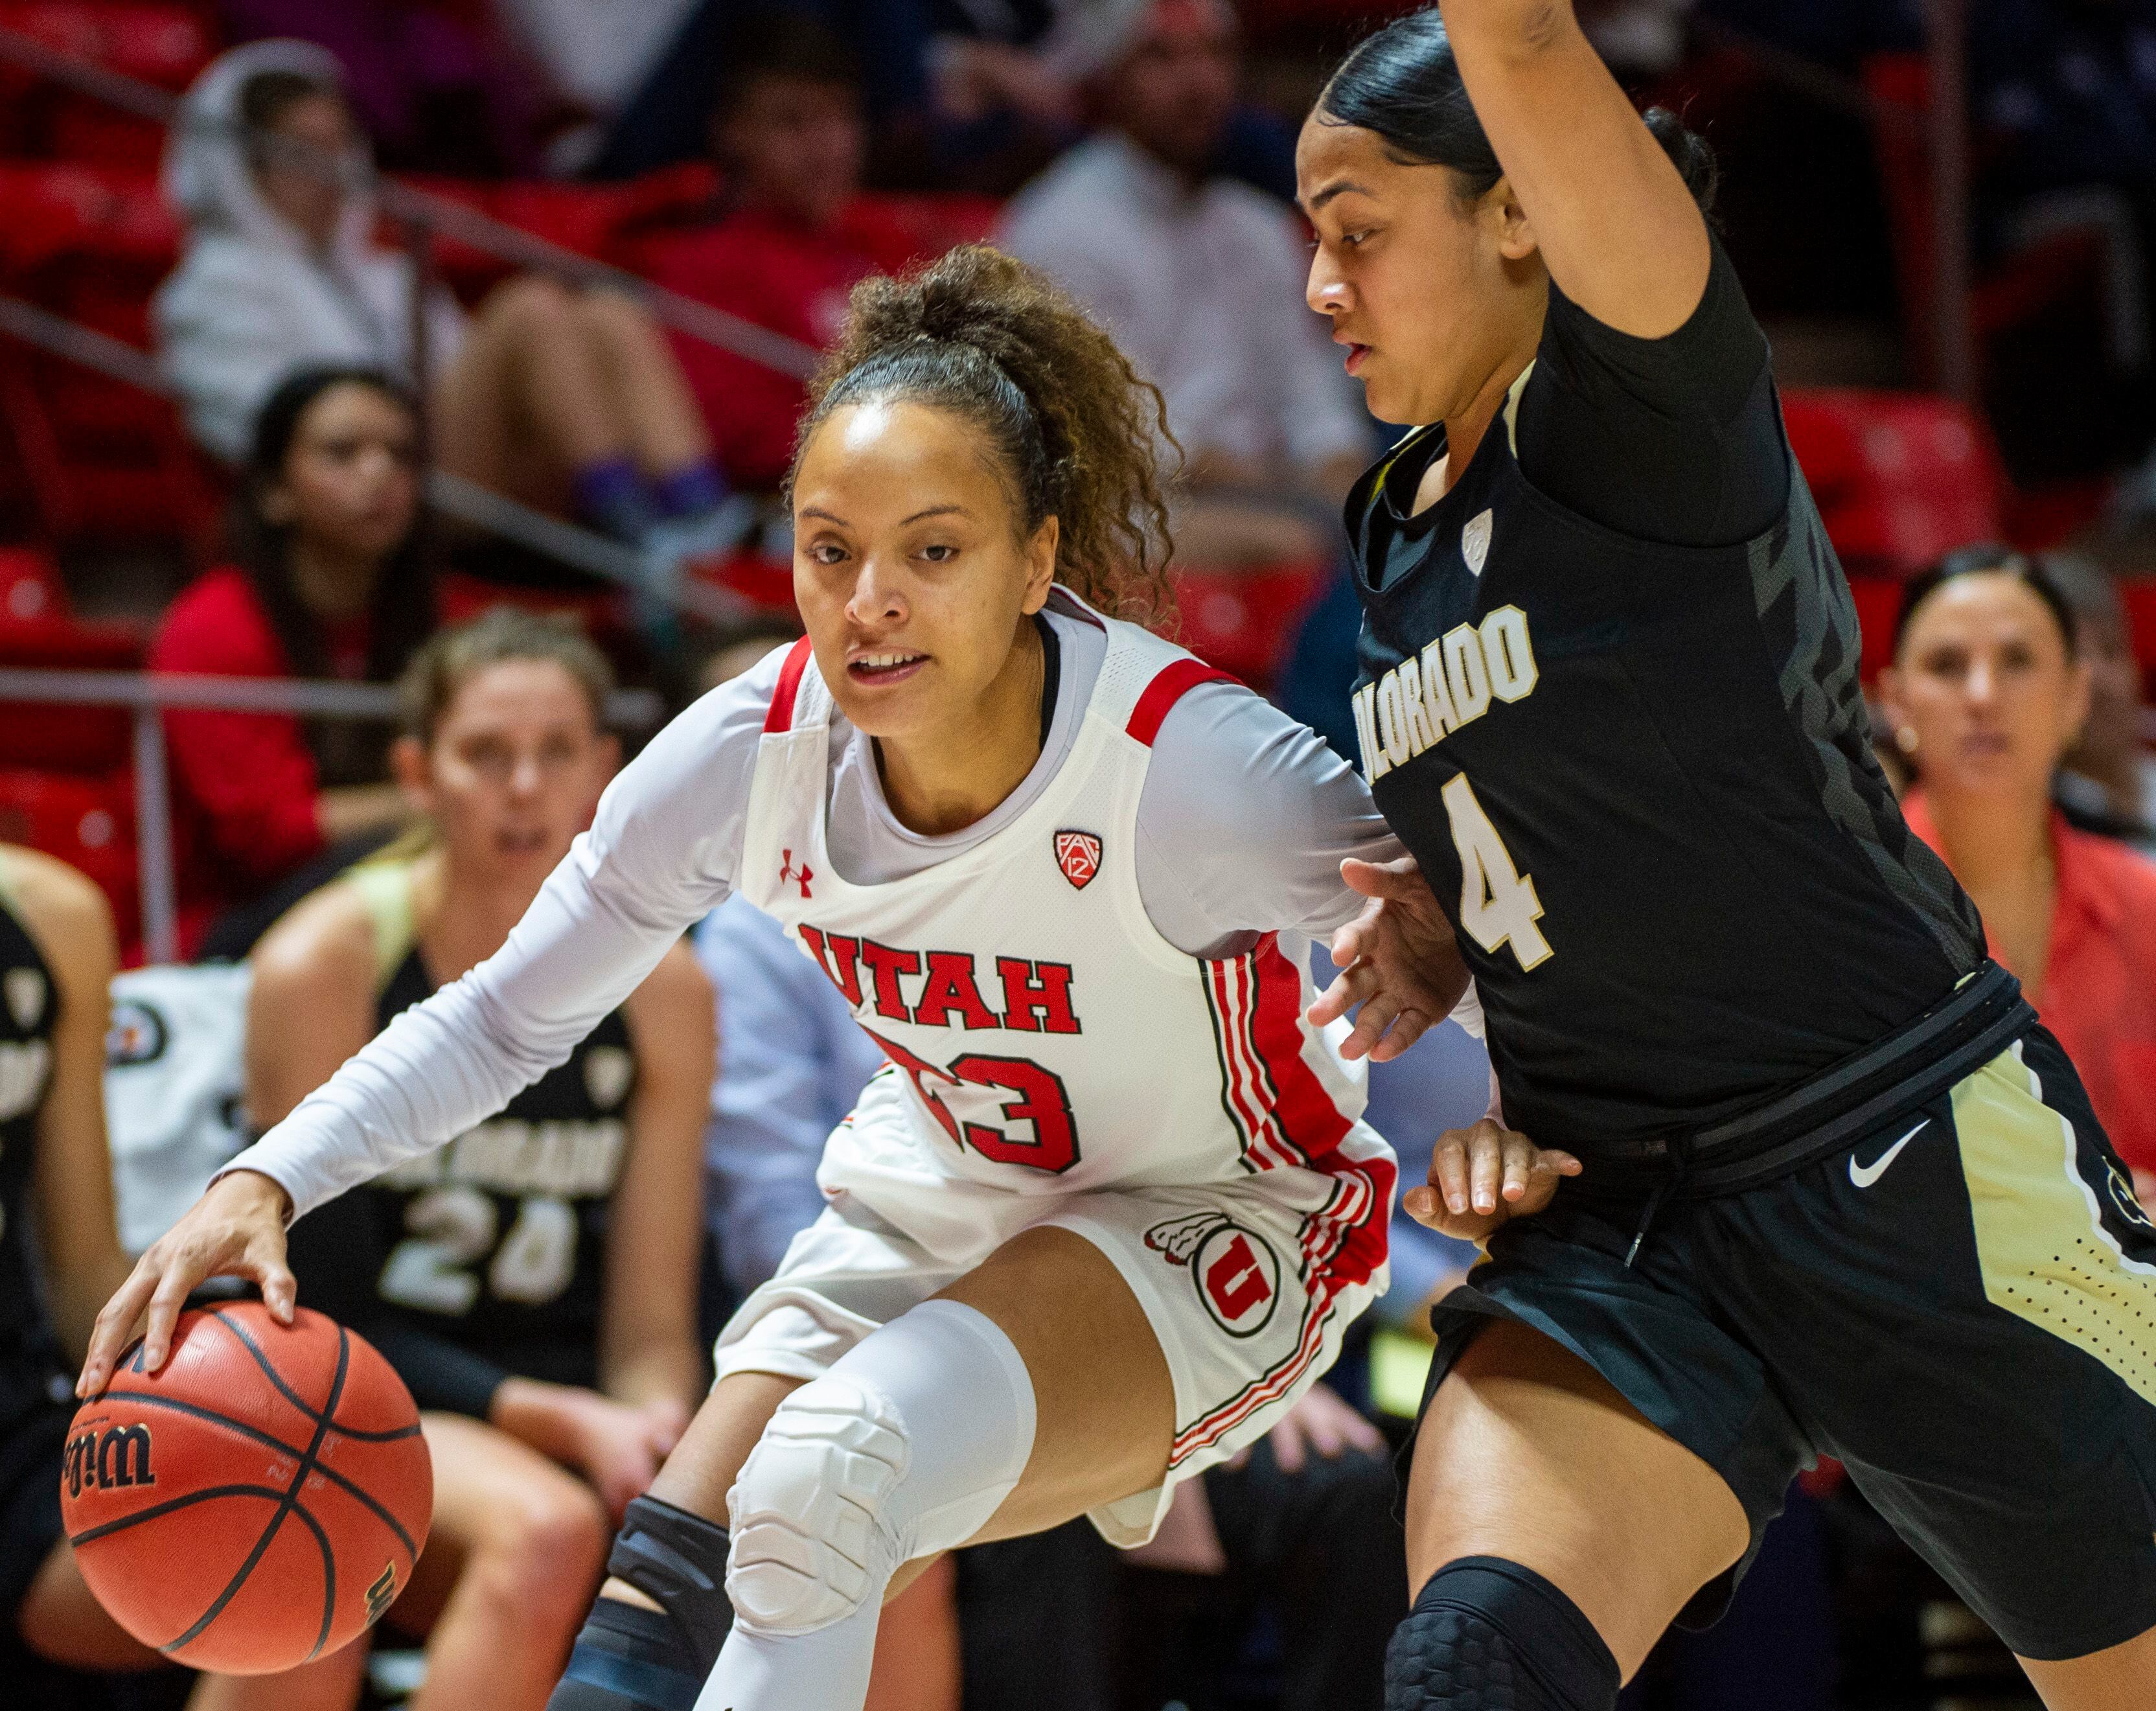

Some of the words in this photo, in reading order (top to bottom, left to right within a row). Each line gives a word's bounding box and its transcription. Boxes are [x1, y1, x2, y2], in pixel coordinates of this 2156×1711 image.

[1352, 604, 1539, 787] OLORADO
[1057, 833, 1100, 869] PAC
[1067, 856, 1090, 878] 12
[1441, 772, 1555, 972] 4
[797, 923, 1082, 1035] UTAH
[1206, 1233, 1272, 1320] U
